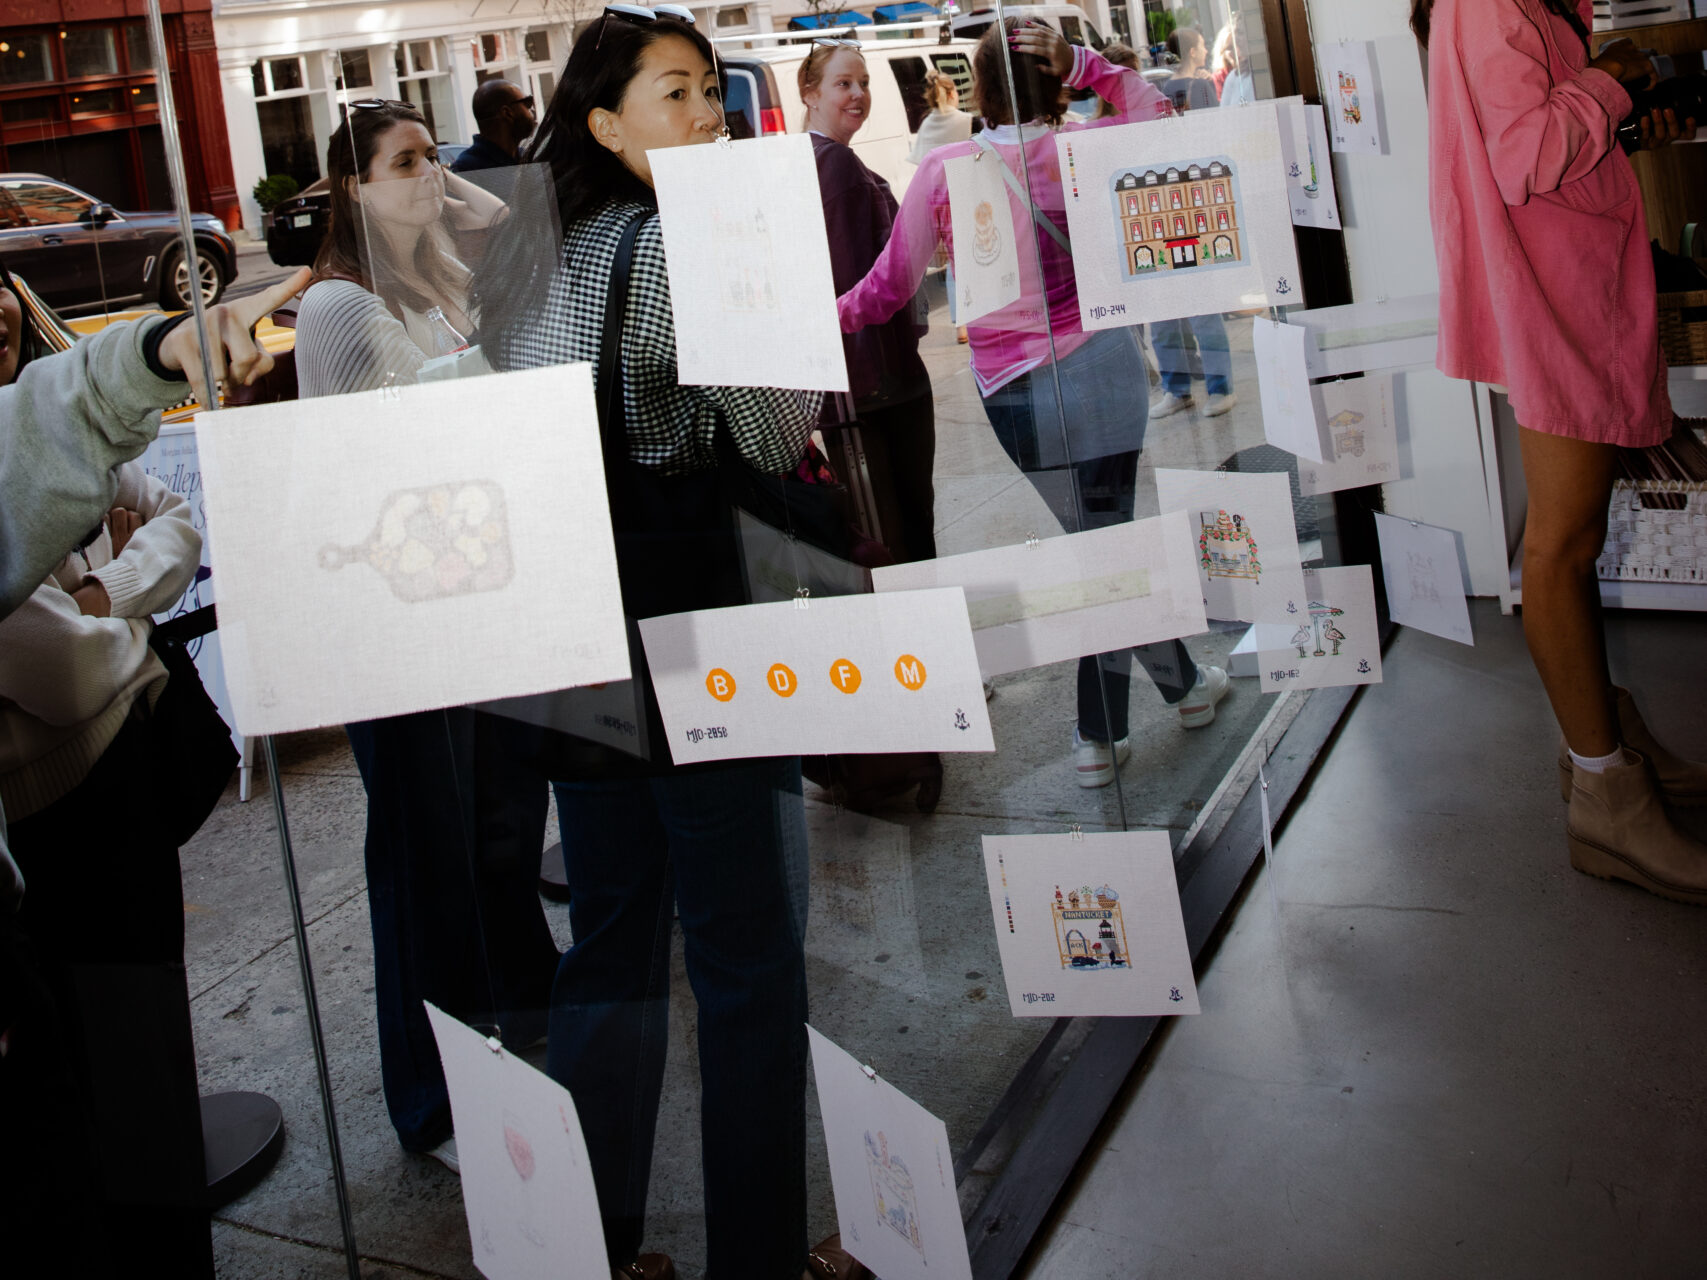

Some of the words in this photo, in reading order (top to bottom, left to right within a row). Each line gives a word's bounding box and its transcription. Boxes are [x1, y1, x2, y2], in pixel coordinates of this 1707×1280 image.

[1090, 303, 1126, 320] MJD-244
[713, 675, 729, 696] B
[774, 670, 791, 692] D
[838, 665, 852, 688] F
[901, 661, 920, 684] M
[1022, 992, 1056, 1004] MJD-202
